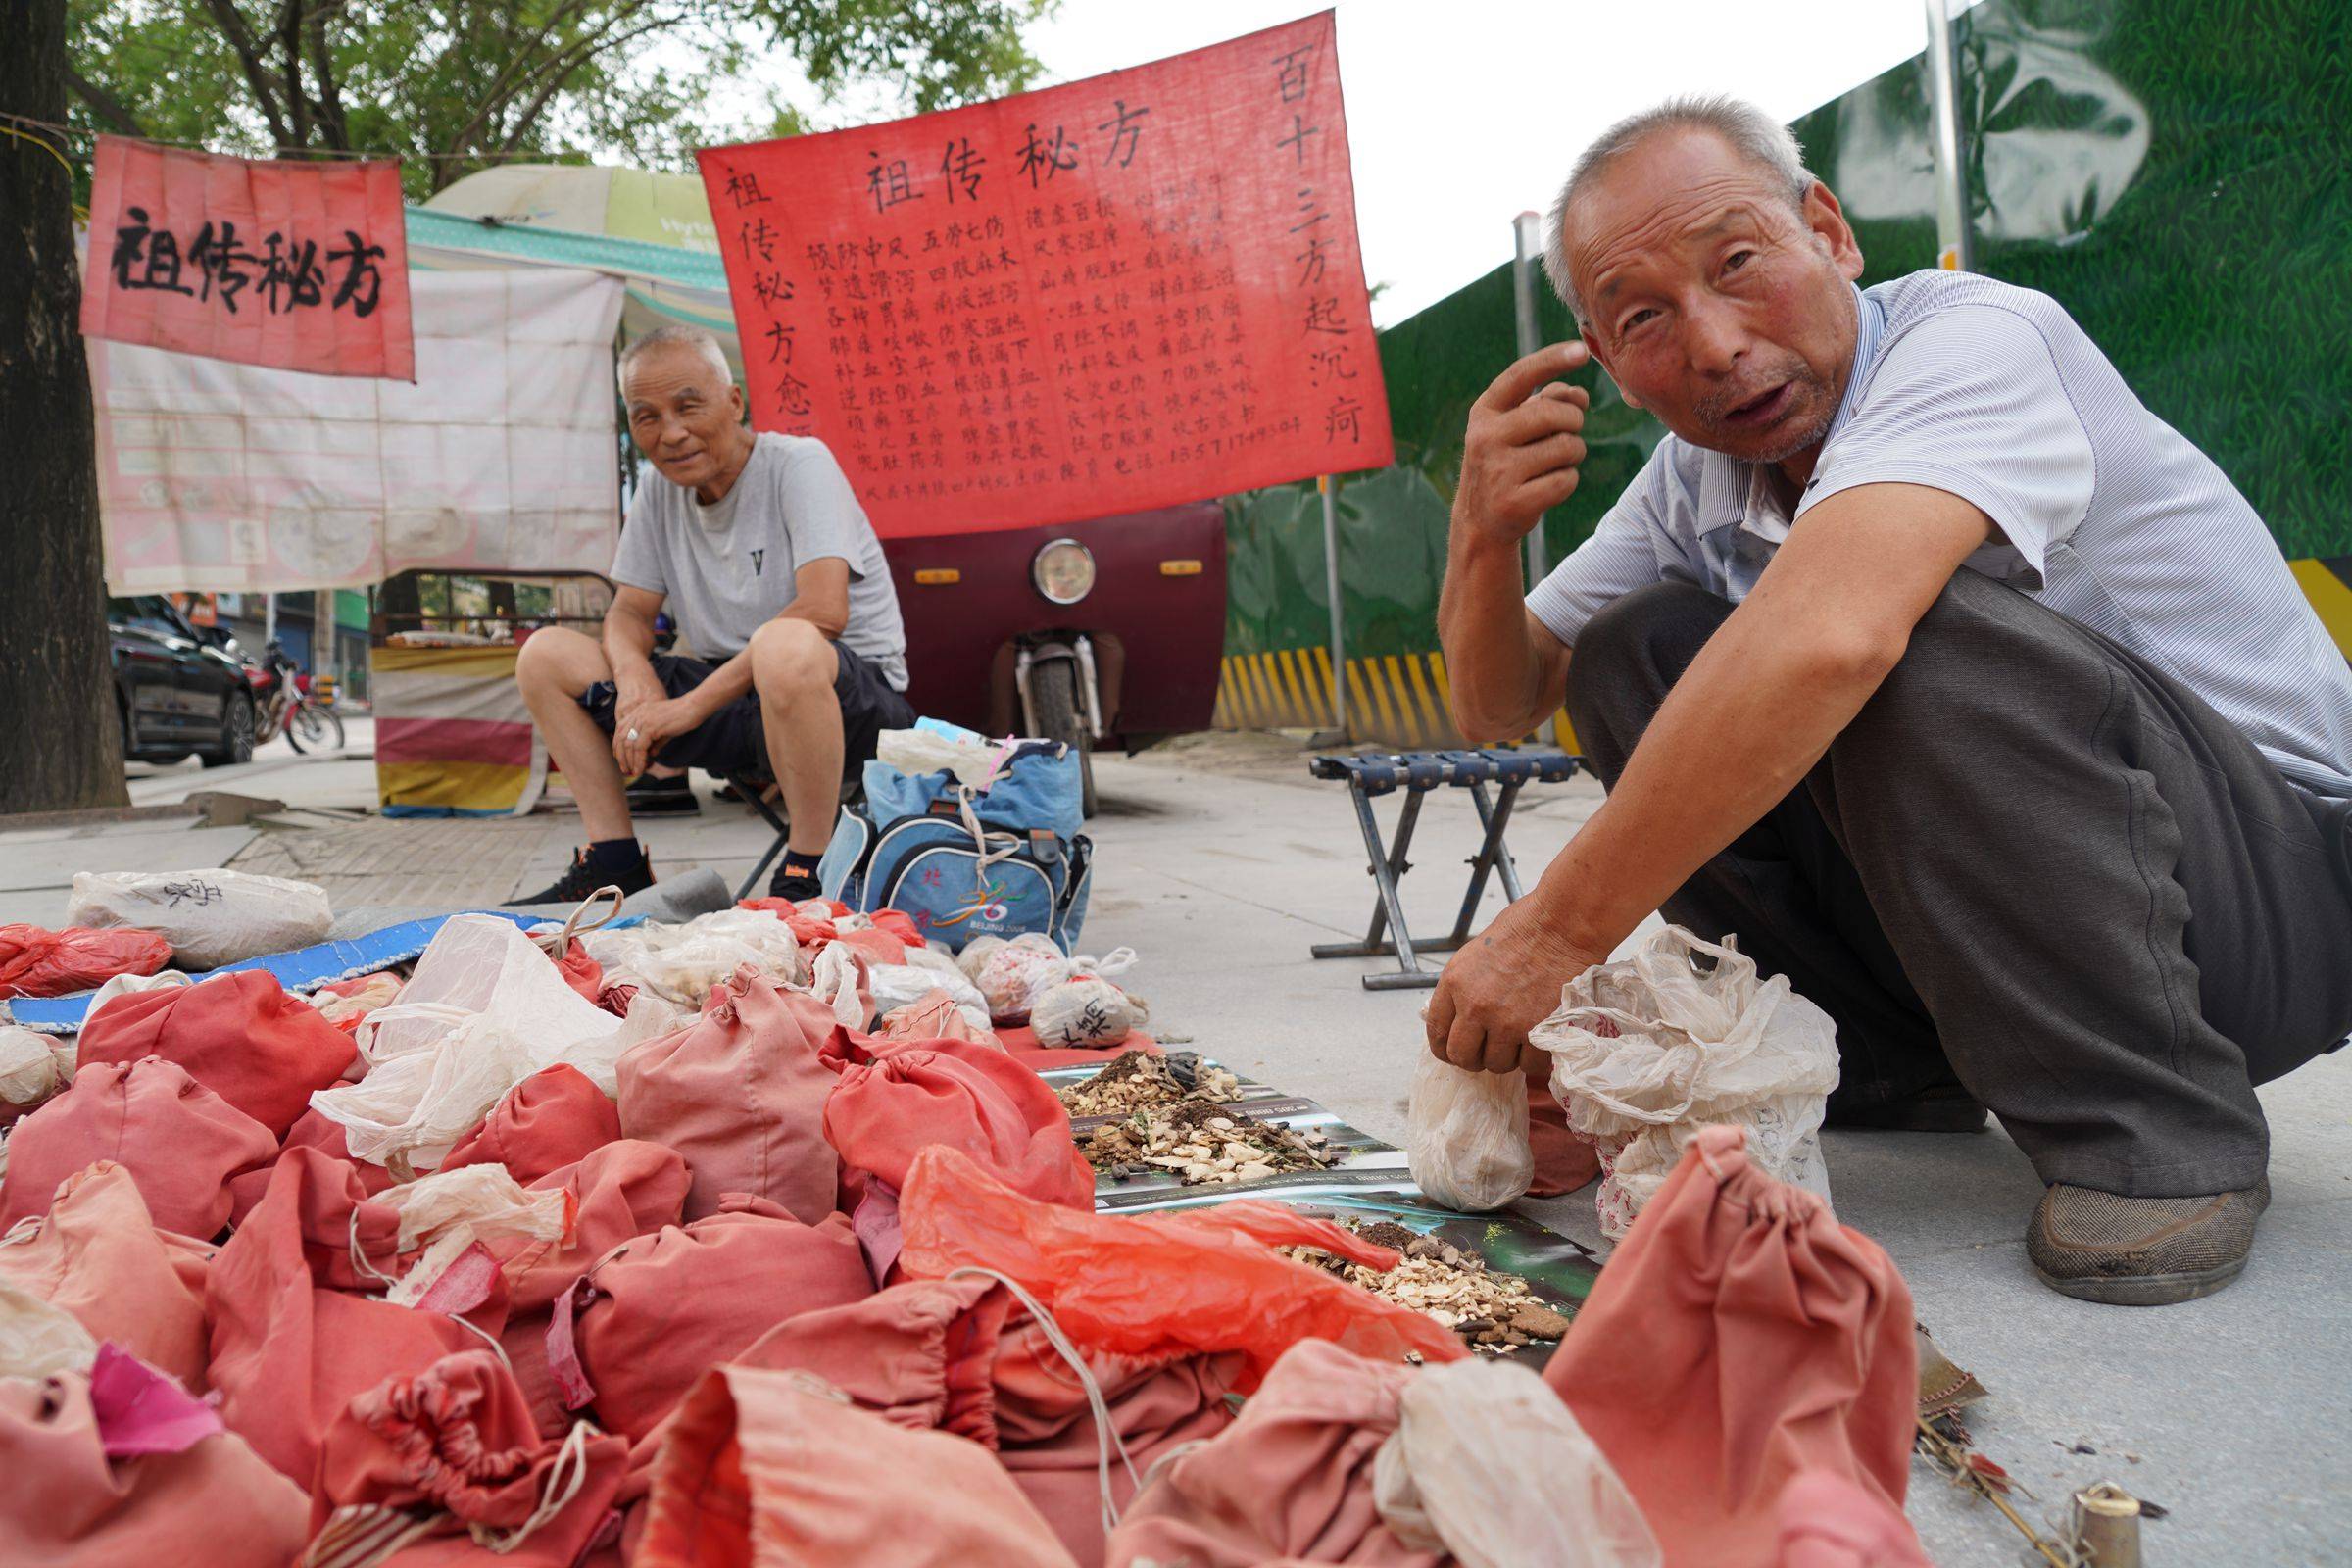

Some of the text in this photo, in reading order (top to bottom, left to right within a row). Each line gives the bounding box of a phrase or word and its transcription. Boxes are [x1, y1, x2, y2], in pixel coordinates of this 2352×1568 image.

[865, 99, 1151, 213] 祖传秘方
[112, 206, 385, 318] 祖传秘方
[921, 215, 1004, 252] 五劳七伤
[928, 246, 1018, 282] 四肢麻木
[725, 167, 812, 437] 祖传秘方愈
[969, 920, 1004, 933] BEIJING
